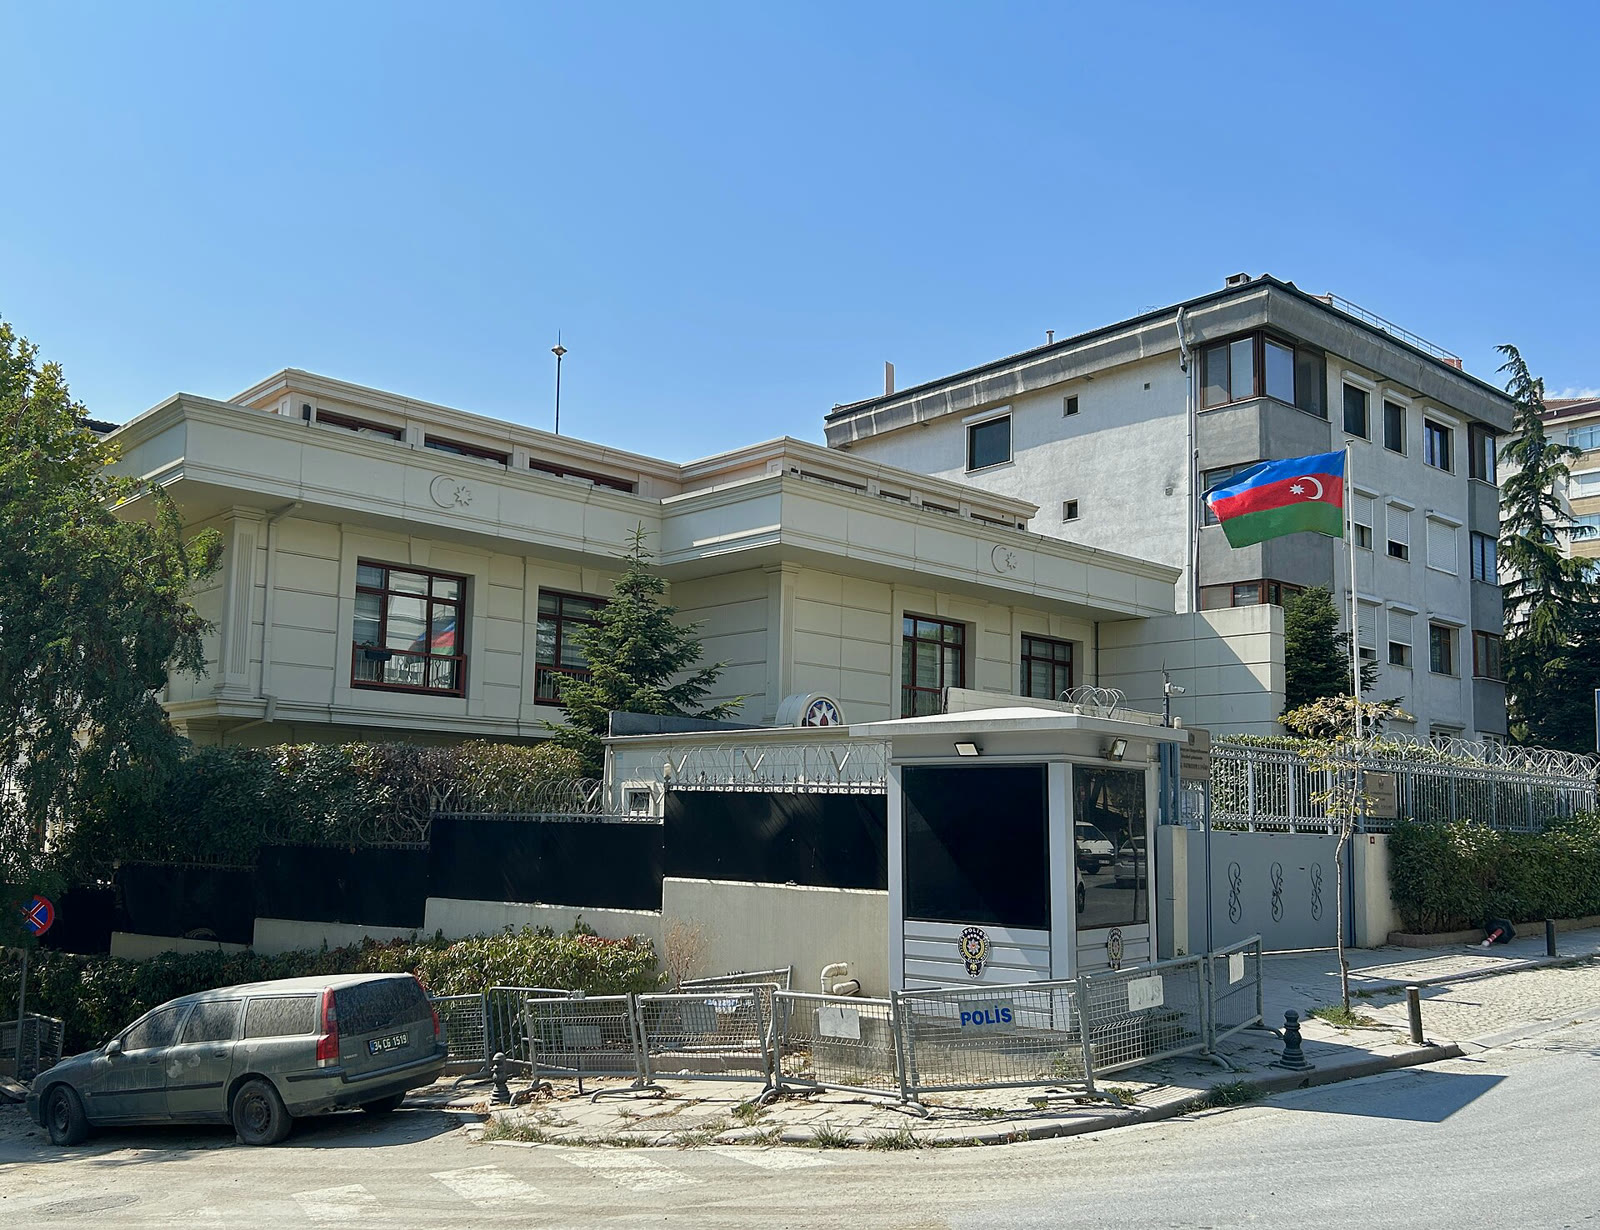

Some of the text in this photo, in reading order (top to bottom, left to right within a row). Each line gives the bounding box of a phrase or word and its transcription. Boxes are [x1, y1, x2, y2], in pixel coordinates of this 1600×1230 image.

[960, 1005, 1012, 1026] POLİS
[374, 1041, 382, 1051] 34
[393, 1034, 407, 1046] 1519
